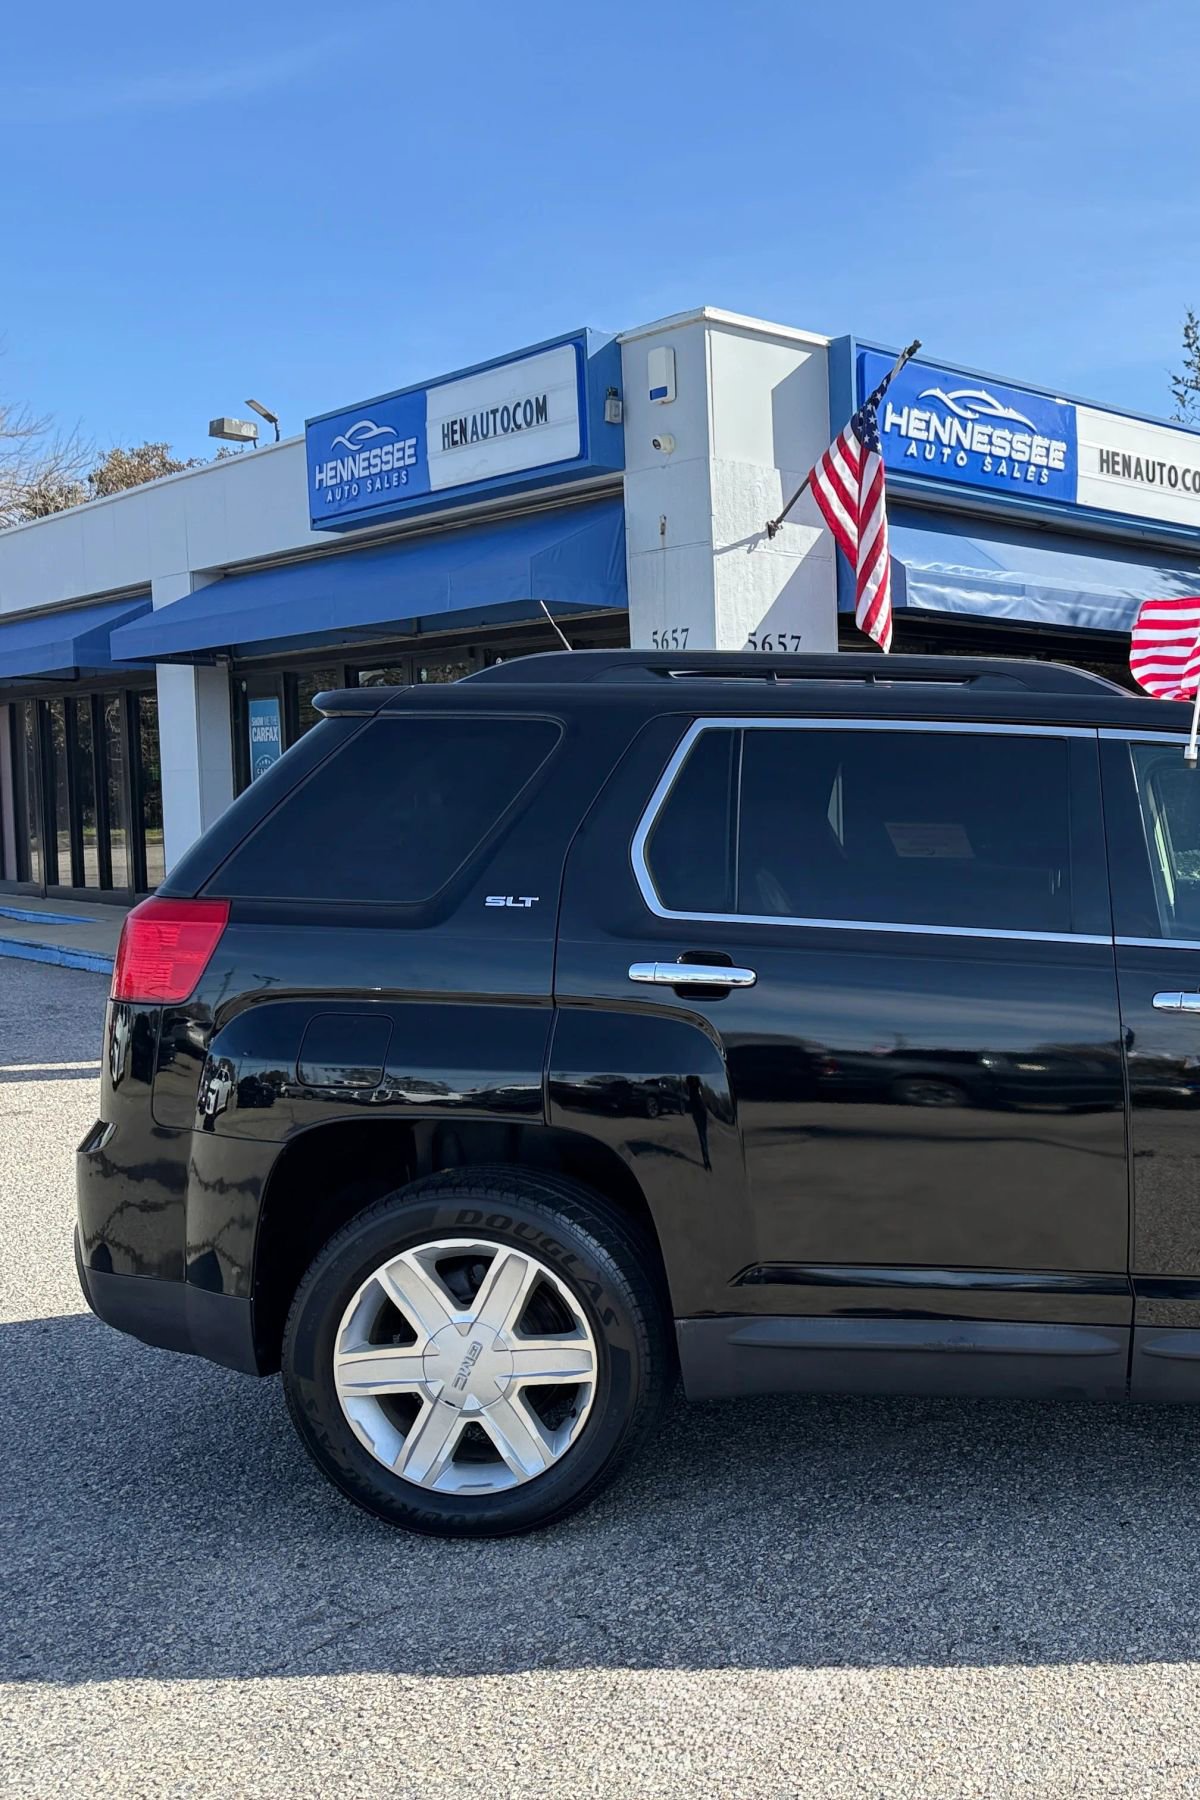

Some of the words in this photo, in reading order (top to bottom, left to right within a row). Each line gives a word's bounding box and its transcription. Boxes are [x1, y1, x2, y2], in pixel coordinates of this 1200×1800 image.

[441, 395, 548, 450] HENAUTO.COM
[884, 402, 1067, 471] HENNESSEE
[315, 437, 418, 490] HENNESSEE
[906, 440, 967, 467] AUTO
[983, 456, 1050, 484] SALES
[326, 482, 359, 504] AUTO
[366, 469, 408, 492] SALES
[652, 627, 690, 650] 5657
[748, 632, 802, 652] 5657
[252, 726, 279, 742] CARFAX
[485, 896, 539, 907] SLT
[453, 1207, 622, 1328] DOUGLAS
[451, 1340, 484, 1392] GMC
